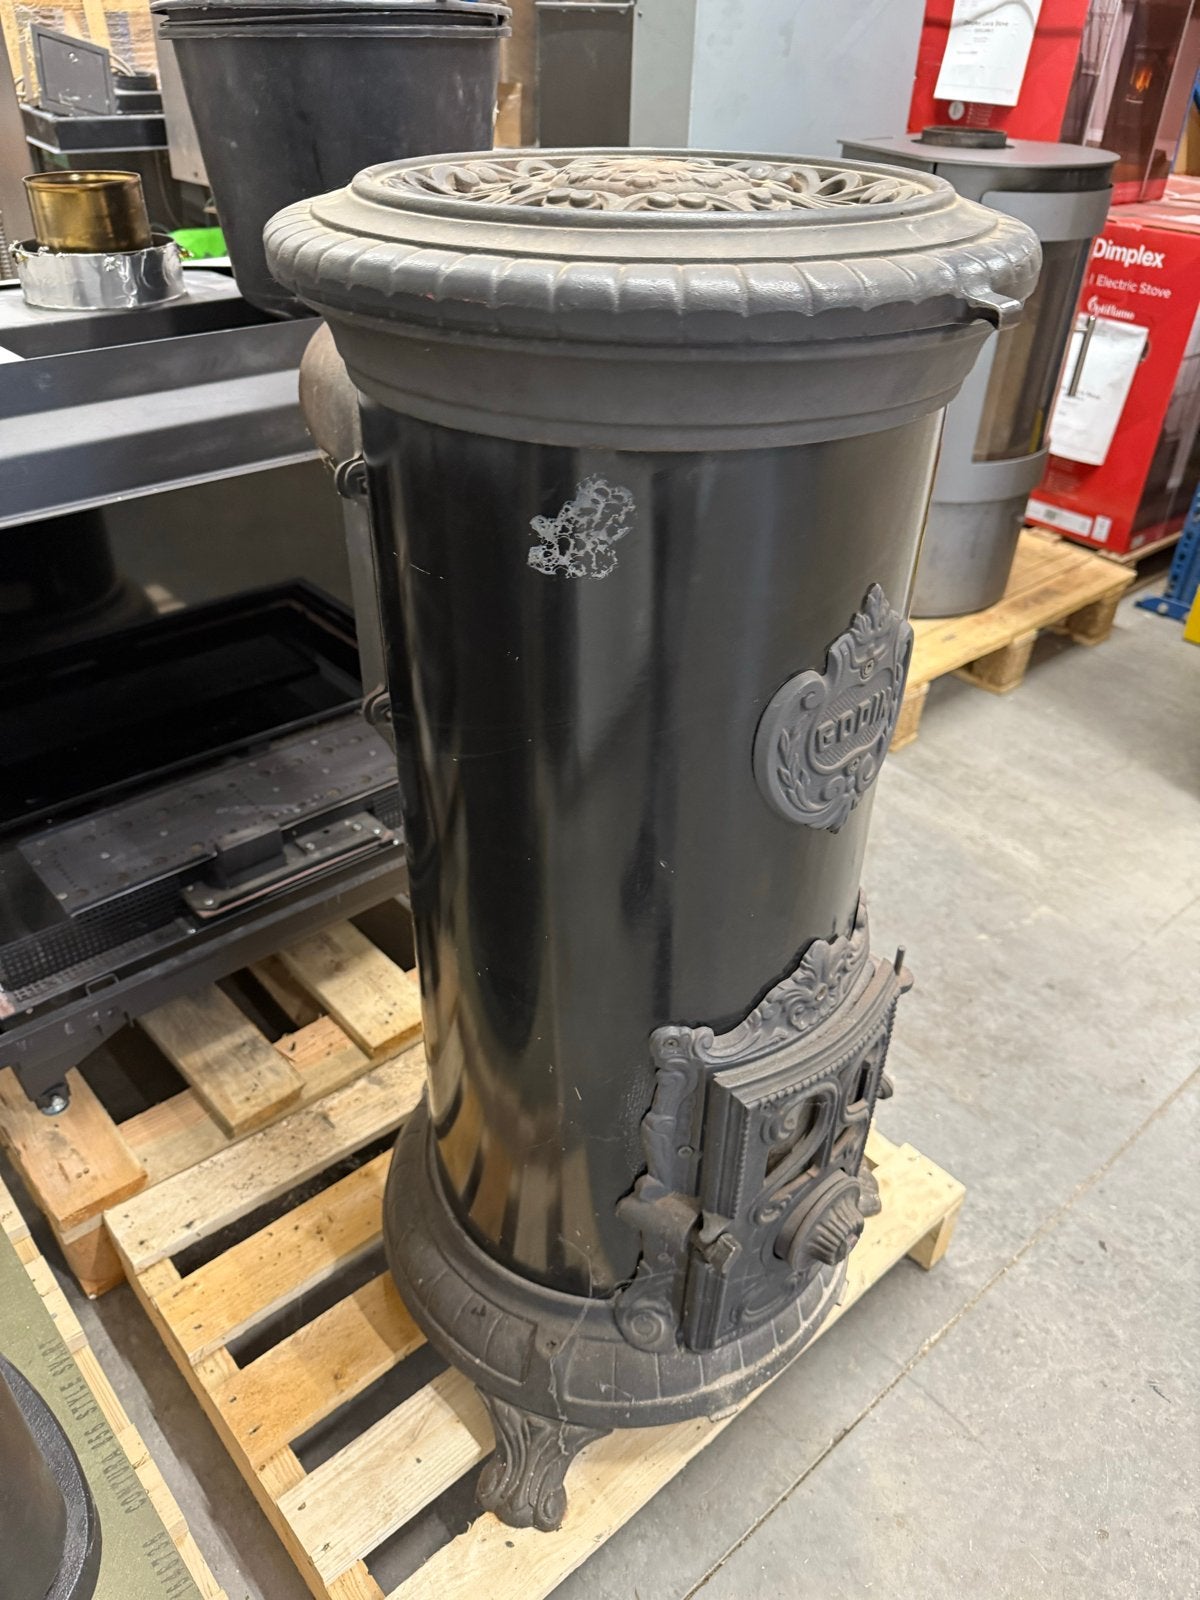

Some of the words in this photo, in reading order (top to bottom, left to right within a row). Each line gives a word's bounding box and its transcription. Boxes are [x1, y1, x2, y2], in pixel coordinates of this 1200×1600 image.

[1092, 237, 1166, 269] Dimplex
[1095, 273, 1138, 293] Electric
[1138, 281, 1172, 299] Stove
[38, 1337, 75, 1377] SVART
[60, 1375, 98, 1421] STYLE
[101, 1448, 149, 1514] CONTURA
